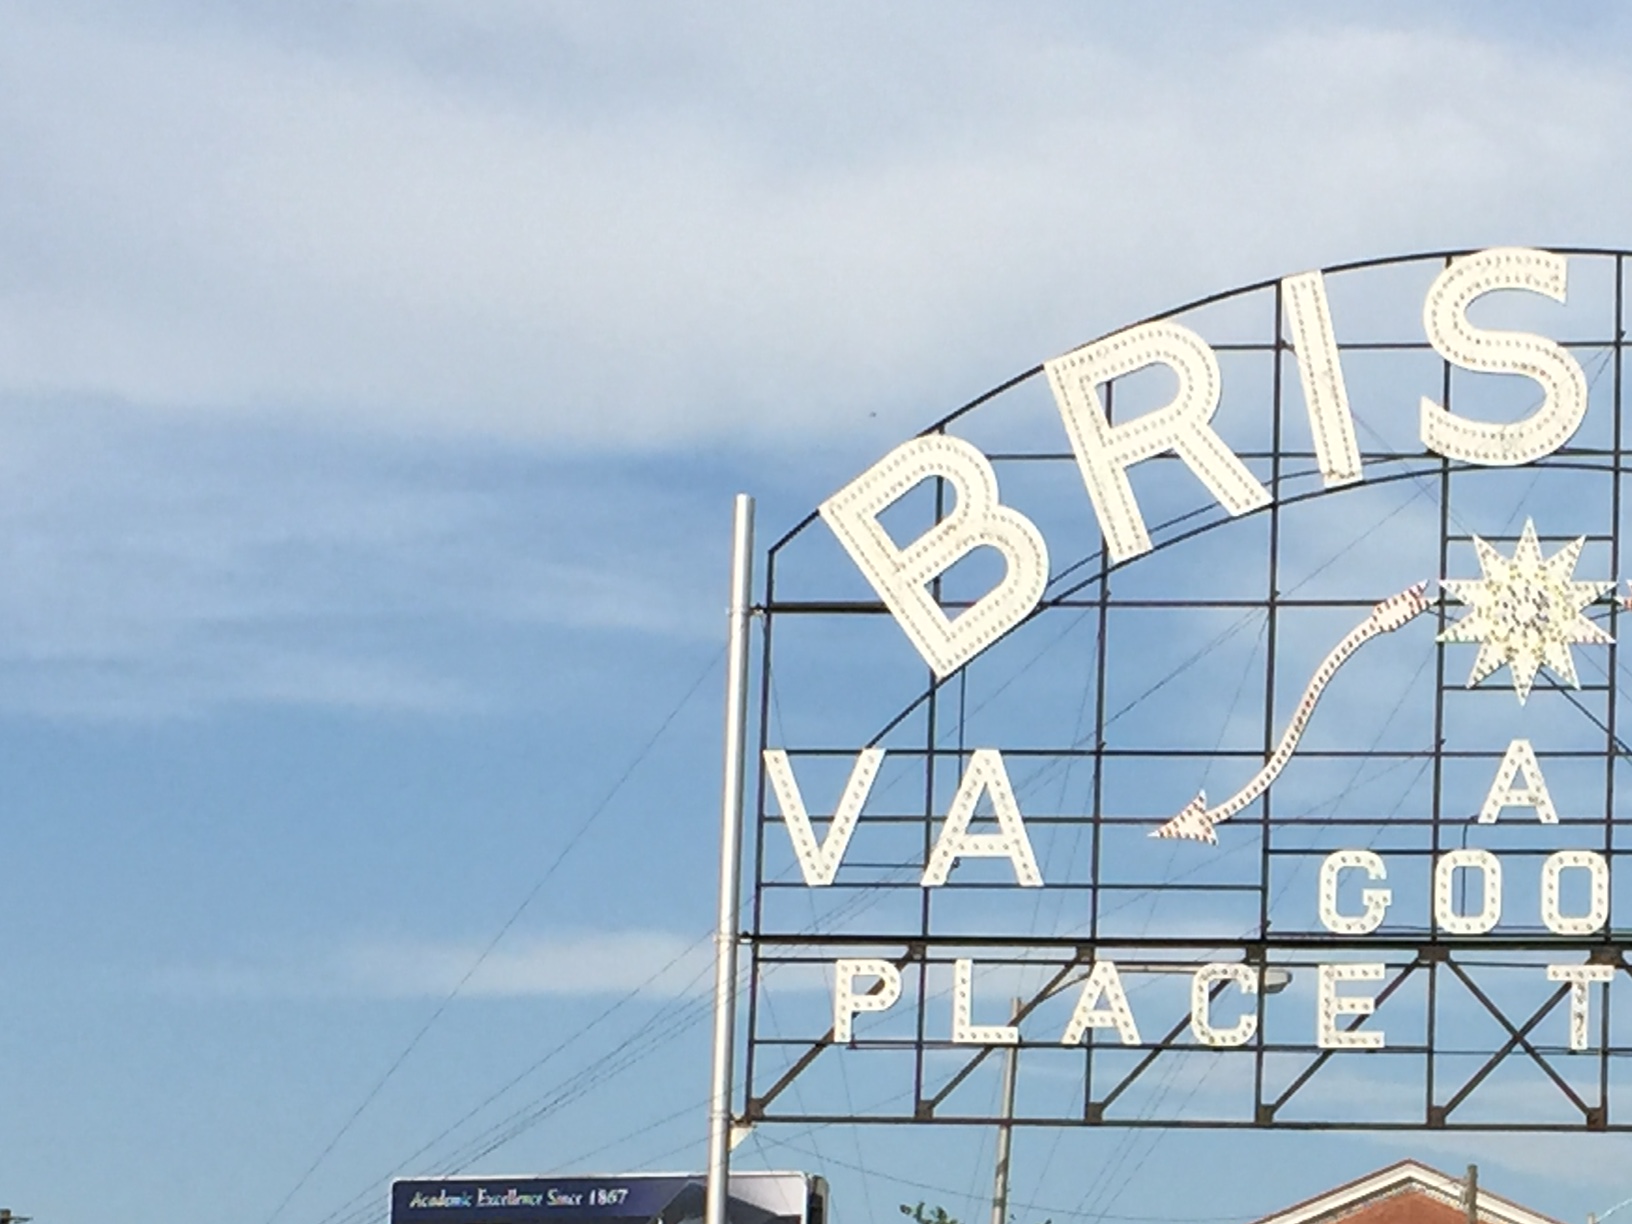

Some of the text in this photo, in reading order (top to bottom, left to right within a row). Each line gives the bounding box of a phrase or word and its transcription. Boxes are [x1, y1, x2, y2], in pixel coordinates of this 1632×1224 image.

[763, 749, 1044, 887] VA
[1478, 740, 1559, 825] A
[833, 959, 1386, 1050] PLACE
[409, 1188, 628, 1208] Academic Excellence Since 1867
